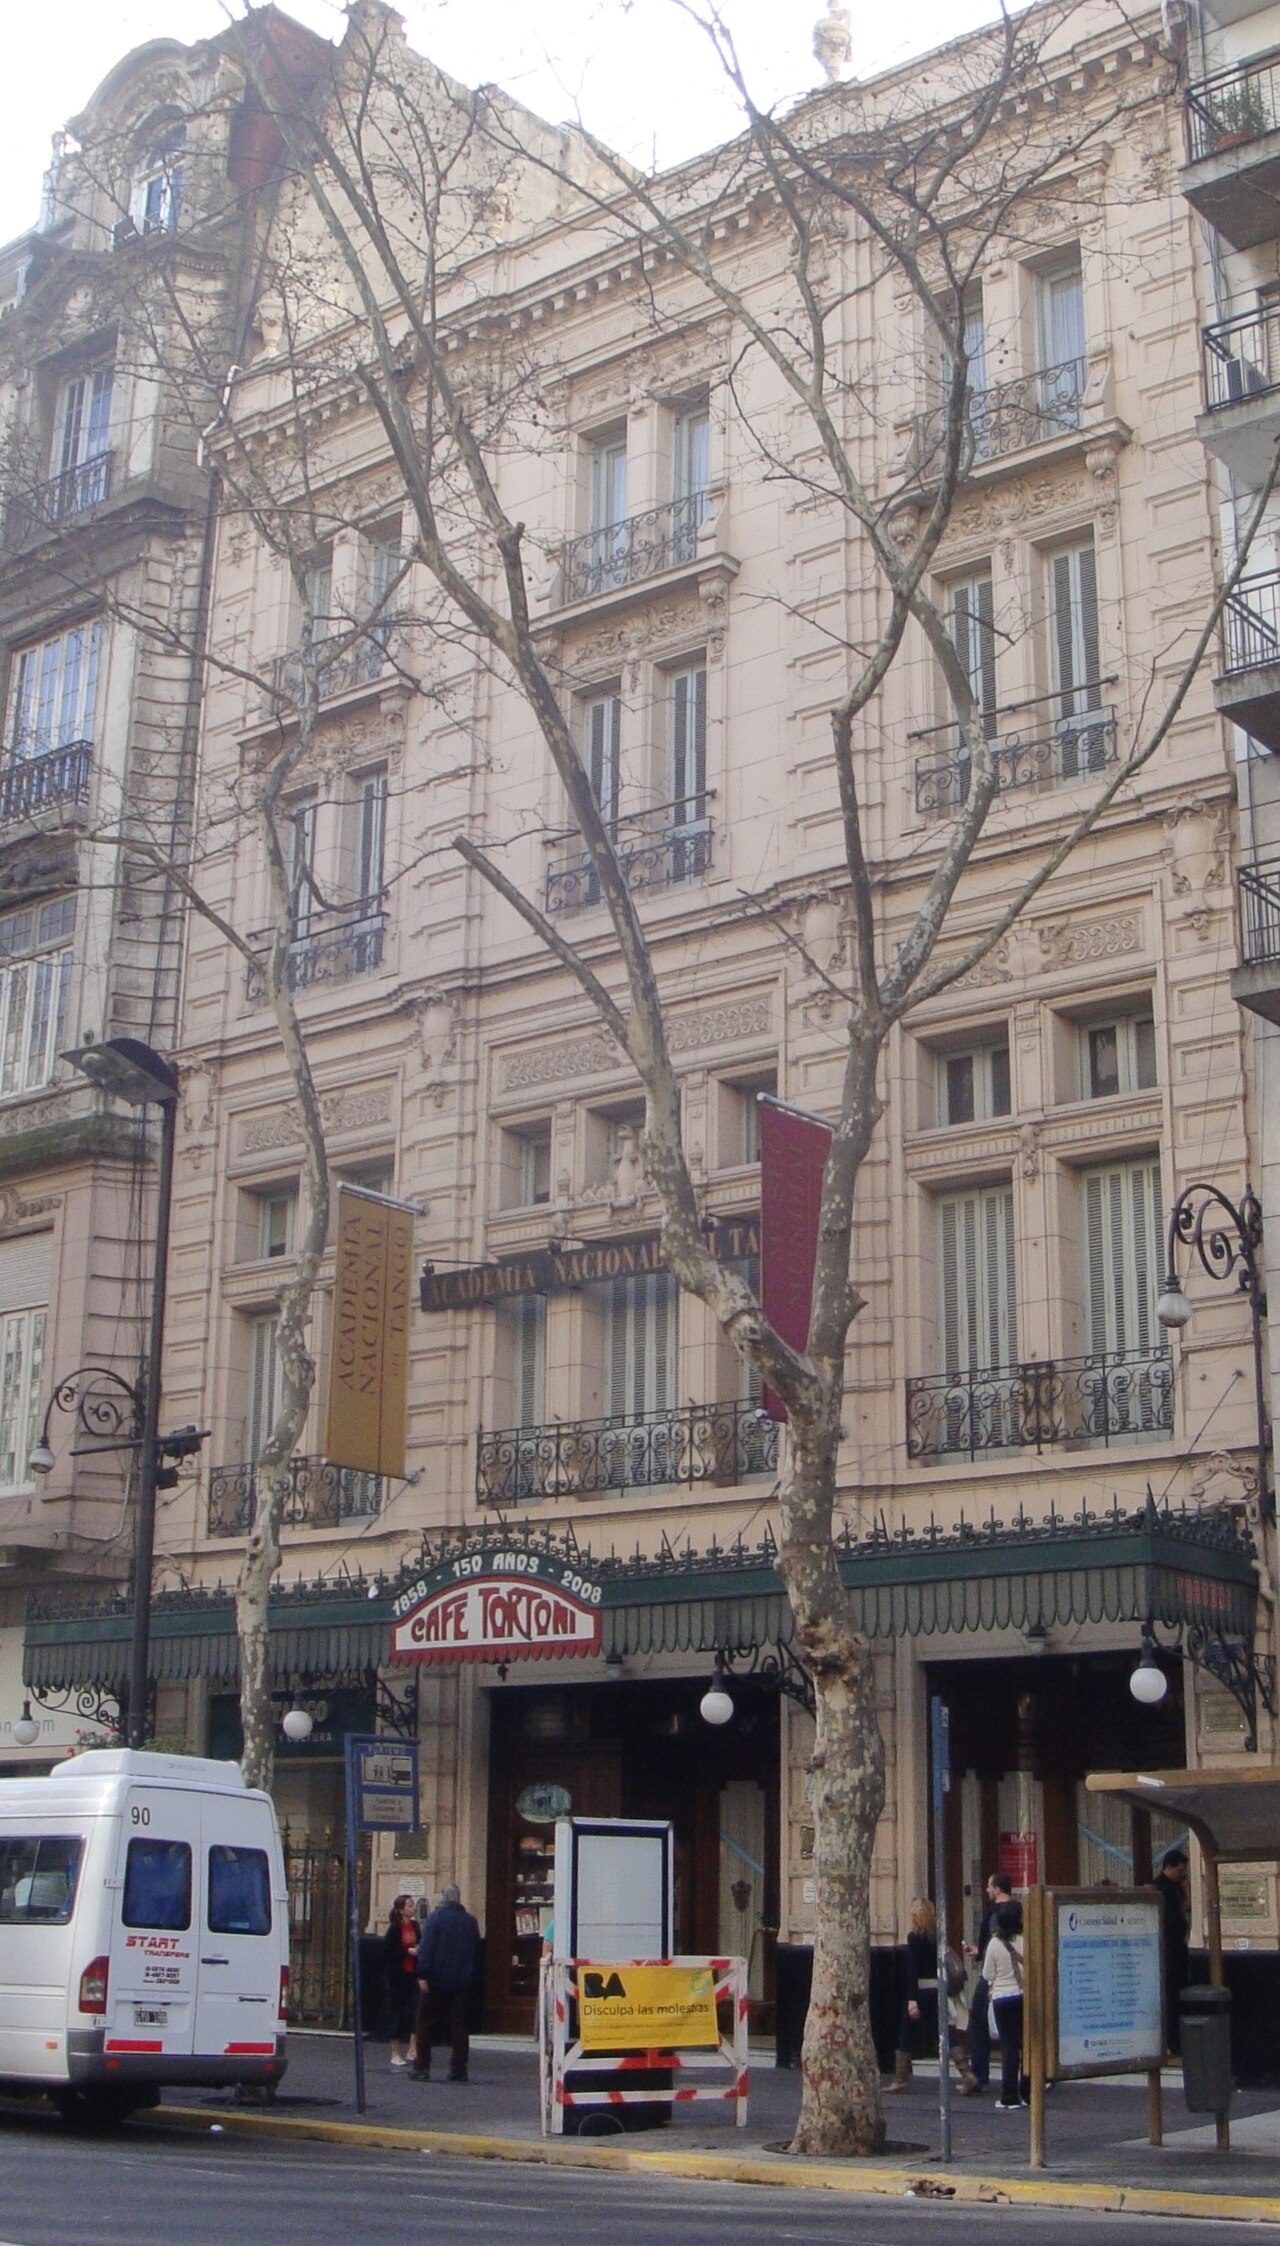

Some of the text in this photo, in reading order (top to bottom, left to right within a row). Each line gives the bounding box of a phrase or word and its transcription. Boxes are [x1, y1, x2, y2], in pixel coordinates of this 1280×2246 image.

[390, 1226, 408, 1339] TANGO
[431, 1264, 536, 1304] ACADEMIA
[553, 1241, 666, 1283] NACIONAL
[338, 1215, 361, 1391] ACADEMIA
[360, 1226, 383, 1395] NACIONAL
[391, 1580, 428, 1616] 1858
[452, 1555, 482, 1578] 150
[492, 1551, 540, 1574] AÑOS
[560, 1569, 603, 1604] 2008
[477, 1586, 577, 1641] TORTONI
[271, 1699, 329, 1723] TAGO
[131, 1805, 151, 1826] 90
[126, 1935, 180, 1949] START
[583, 2002, 709, 2016] Disculpá las molestias
